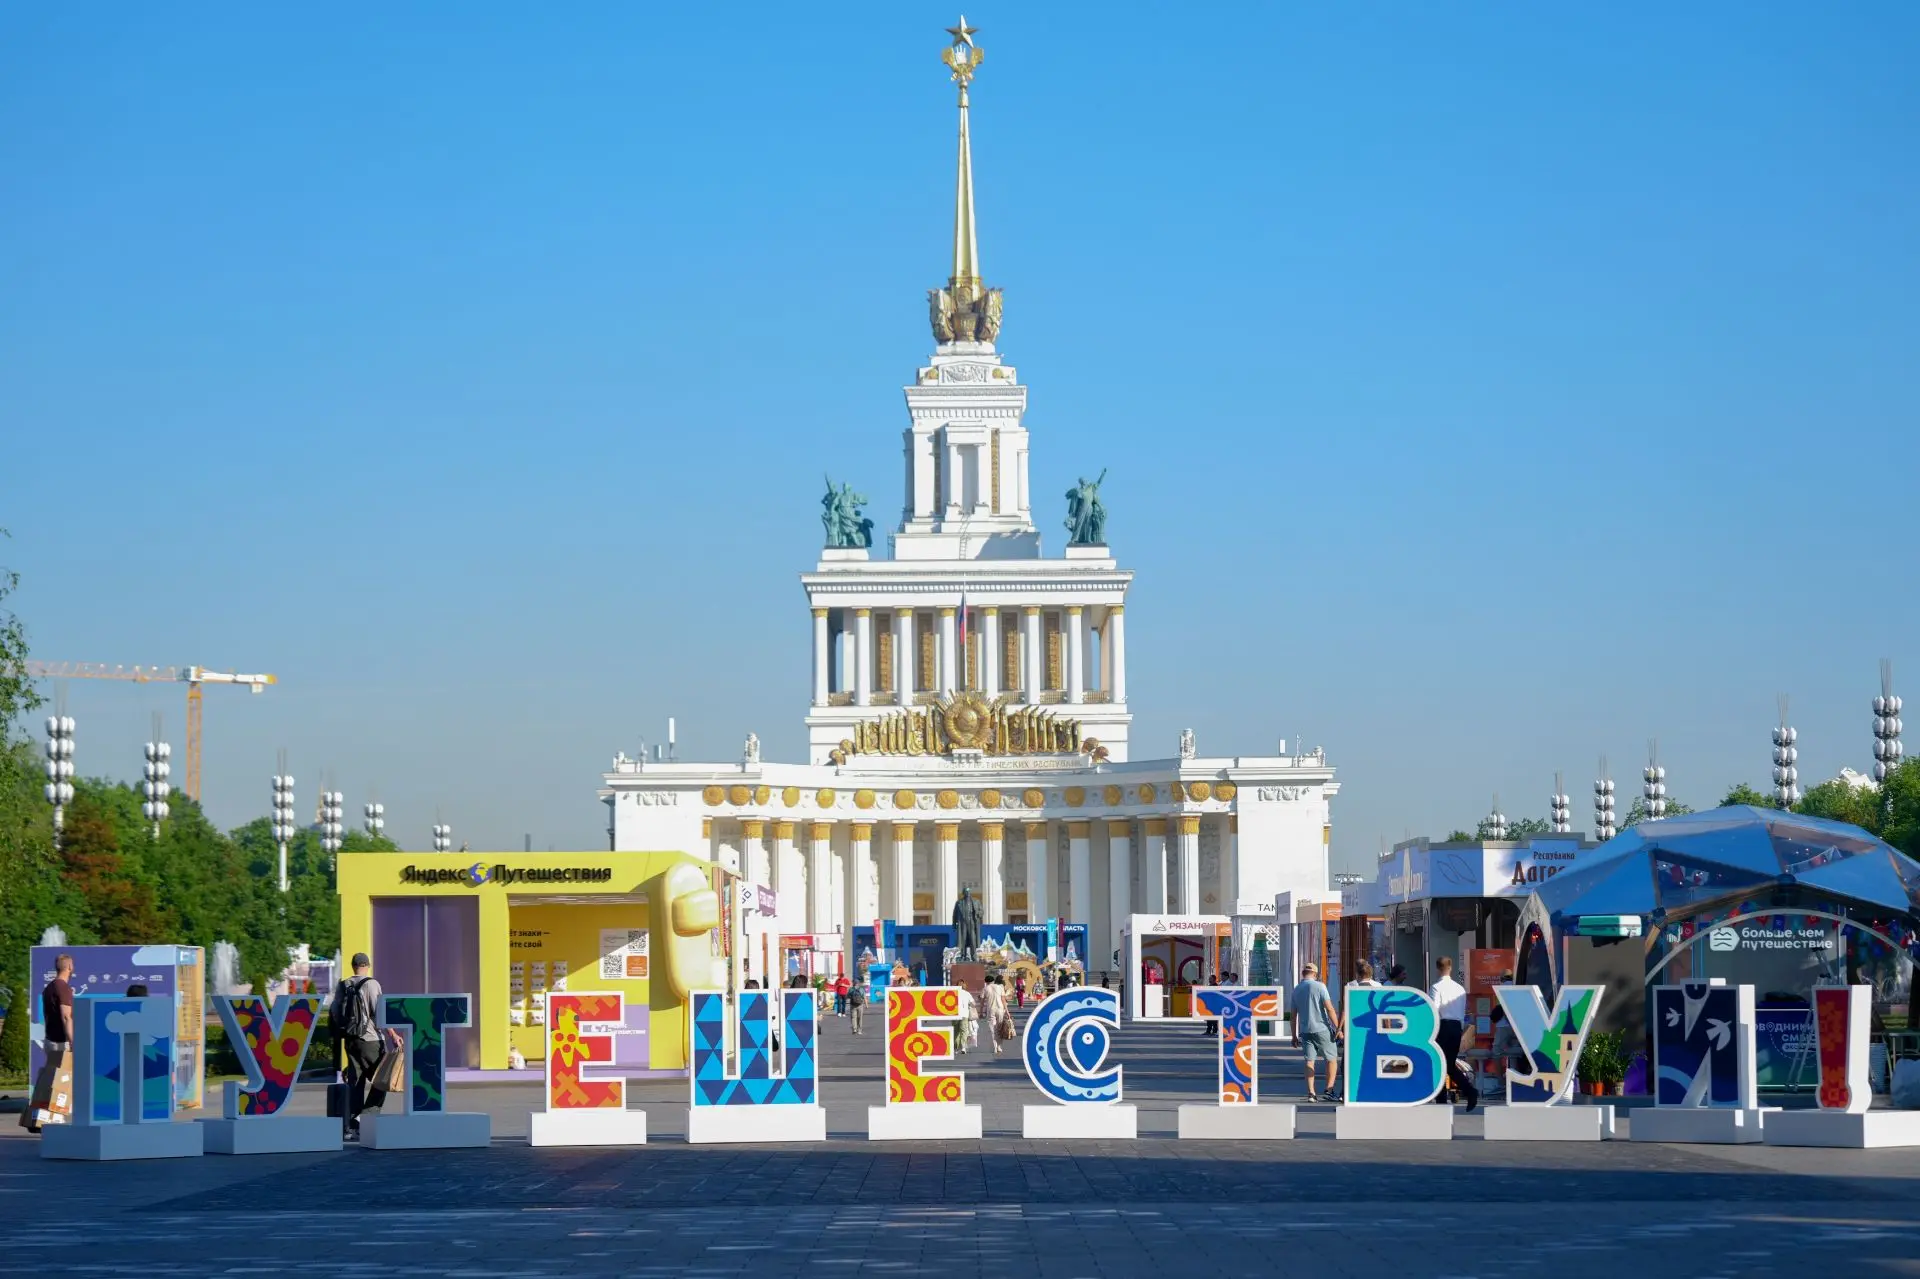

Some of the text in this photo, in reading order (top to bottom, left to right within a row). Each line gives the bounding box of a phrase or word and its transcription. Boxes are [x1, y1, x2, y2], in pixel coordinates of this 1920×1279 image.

[1533, 851, 1576, 860] Республика
[404, 864, 612, 885] Яндекс Путешествия
[1741, 927, 1825, 939] больше, чем
[523, 940, 542, 948] свой
[1741, 940, 1833, 951] путешествие
